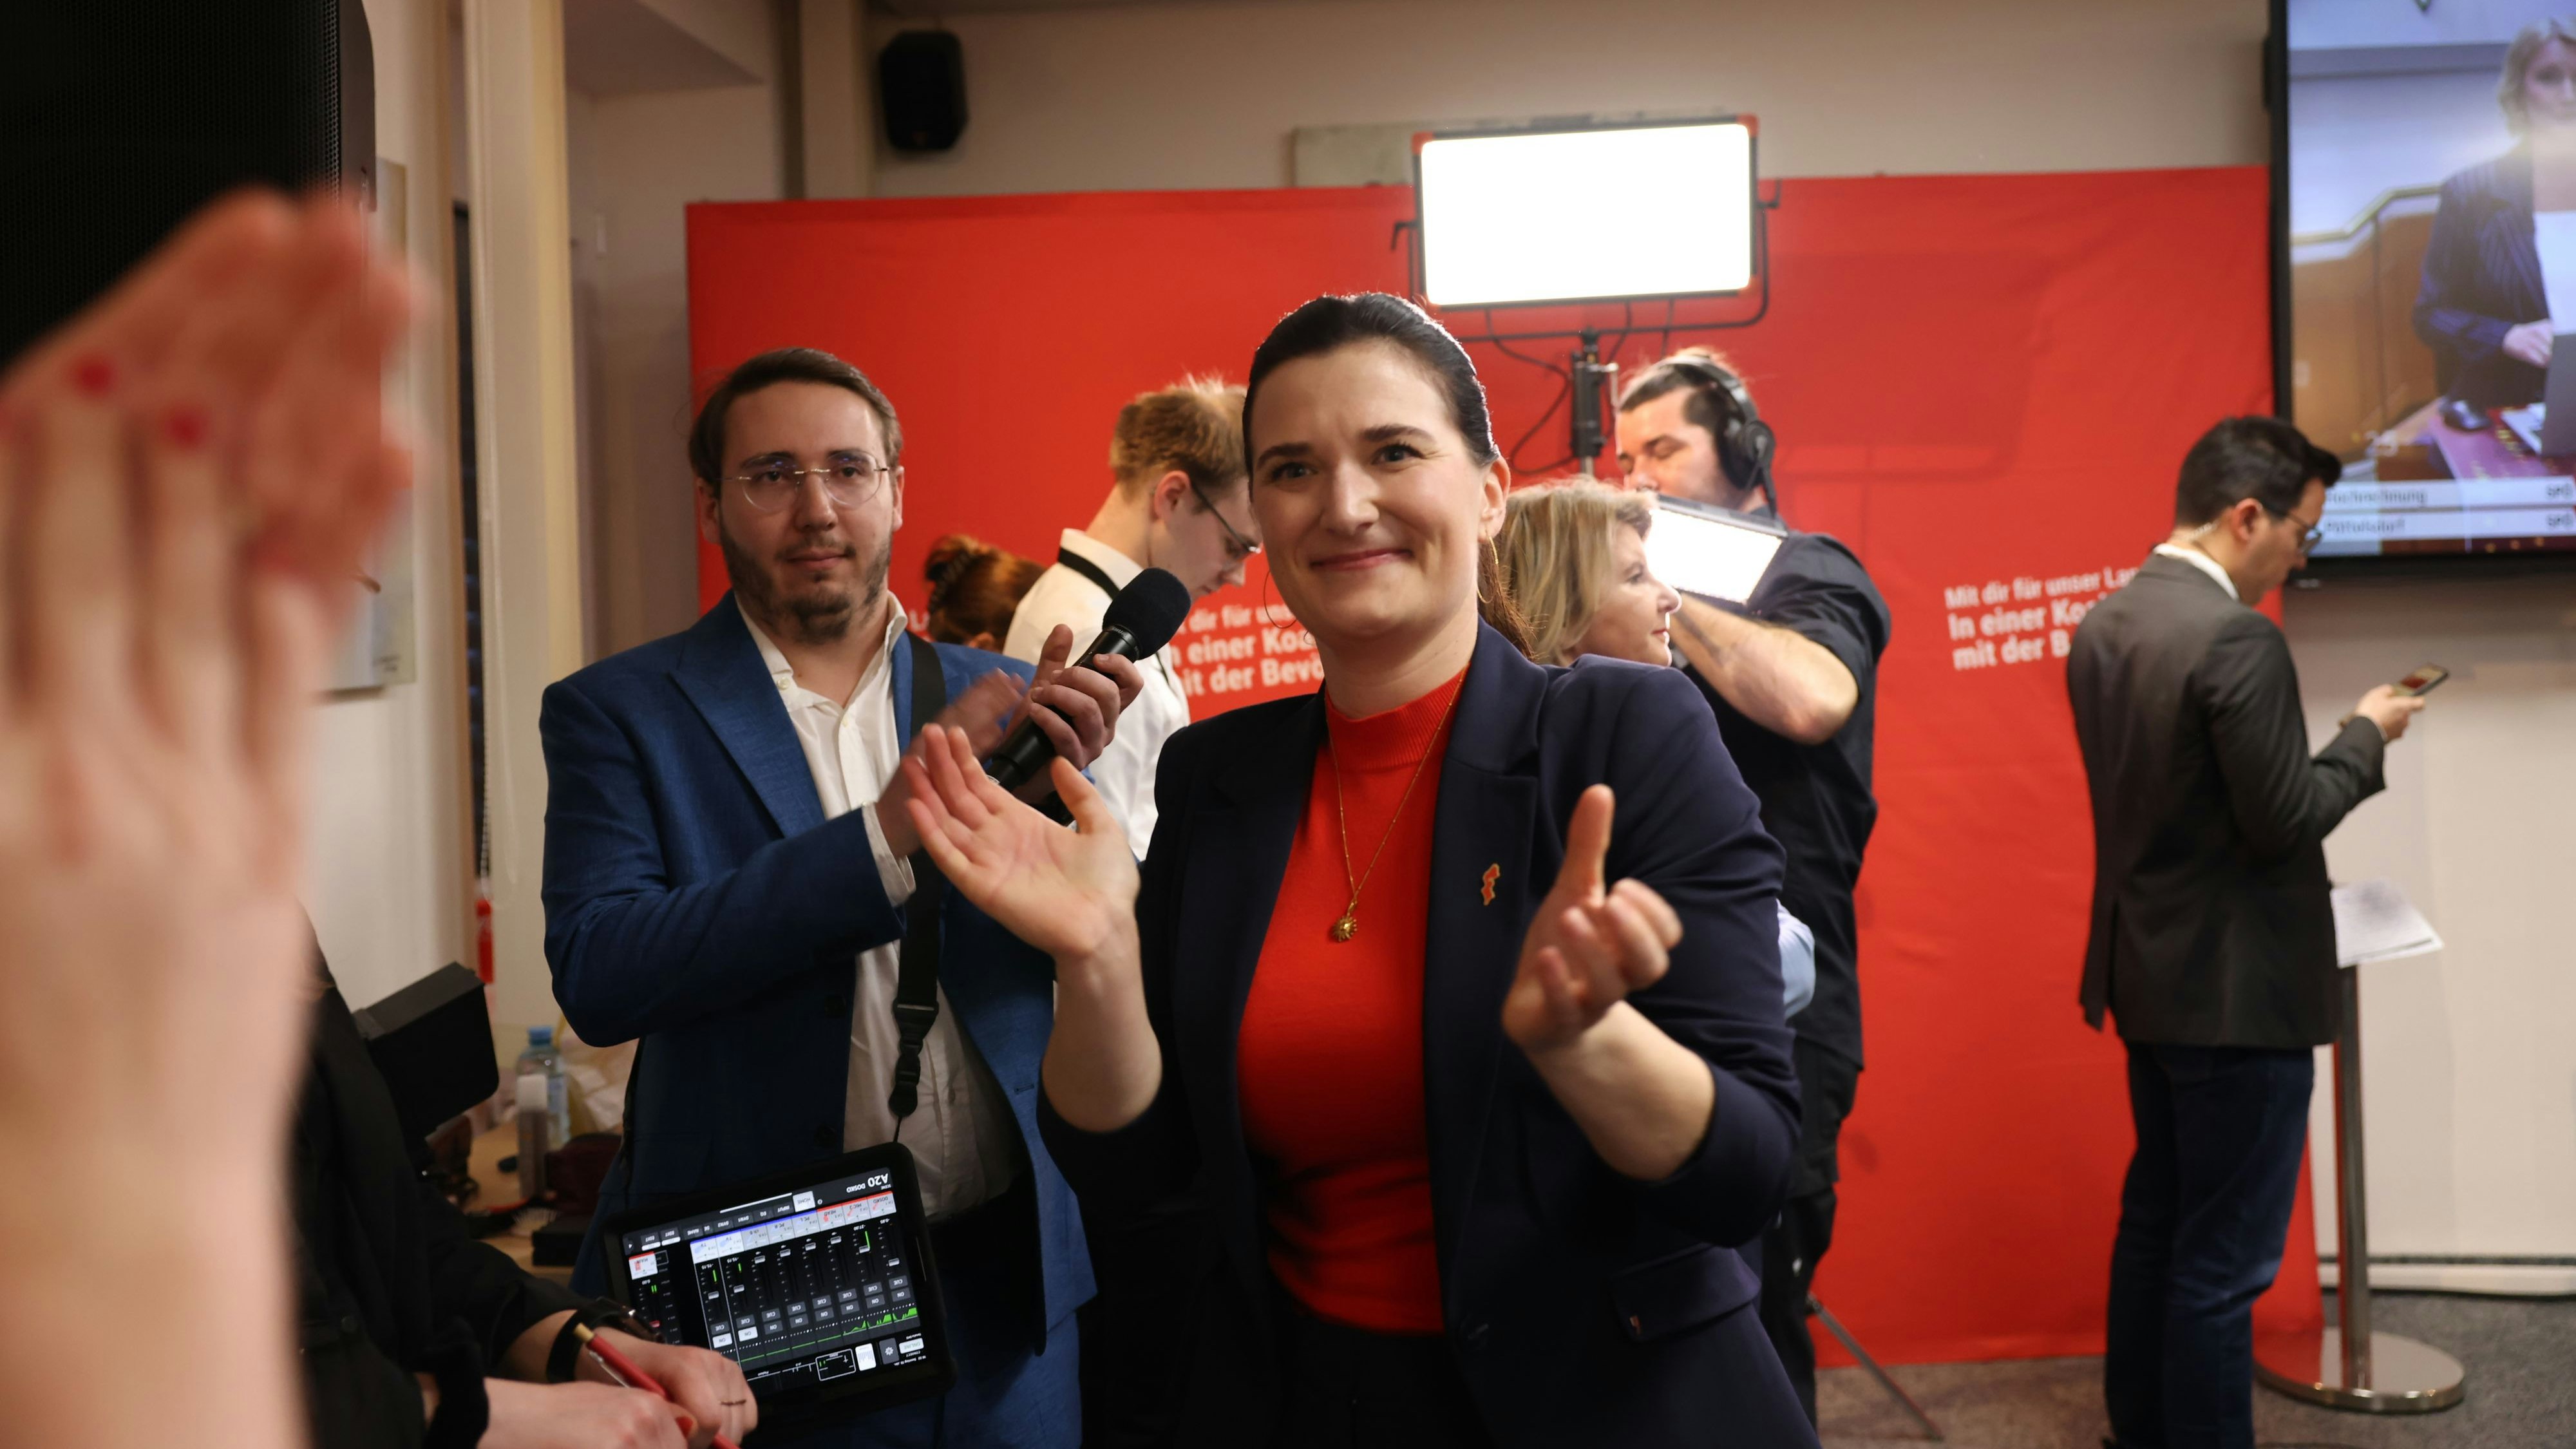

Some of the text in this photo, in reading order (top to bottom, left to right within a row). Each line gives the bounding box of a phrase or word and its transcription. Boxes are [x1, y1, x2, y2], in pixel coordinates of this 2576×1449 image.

[1944, 585, 1980, 610] Mit
[1982, 581, 2010, 605] dir
[2012, 576, 2043, 601] für
[2045, 571, 2101, 597] unser
[1189, 609, 1217, 632] dir
[1222, 604, 1251, 629] für
[1947, 612, 1976, 641] In
[1979, 605, 2047, 636] einer
[1188, 635, 1256, 665] einer
[1262, 627, 1317, 656] Koa
[1952, 639, 1997, 671] mit
[2001, 634, 2045, 665] der
[1182, 652, 1325, 697] it der Bevö
[846, 1173, 889, 1193] A20 DOSKO
